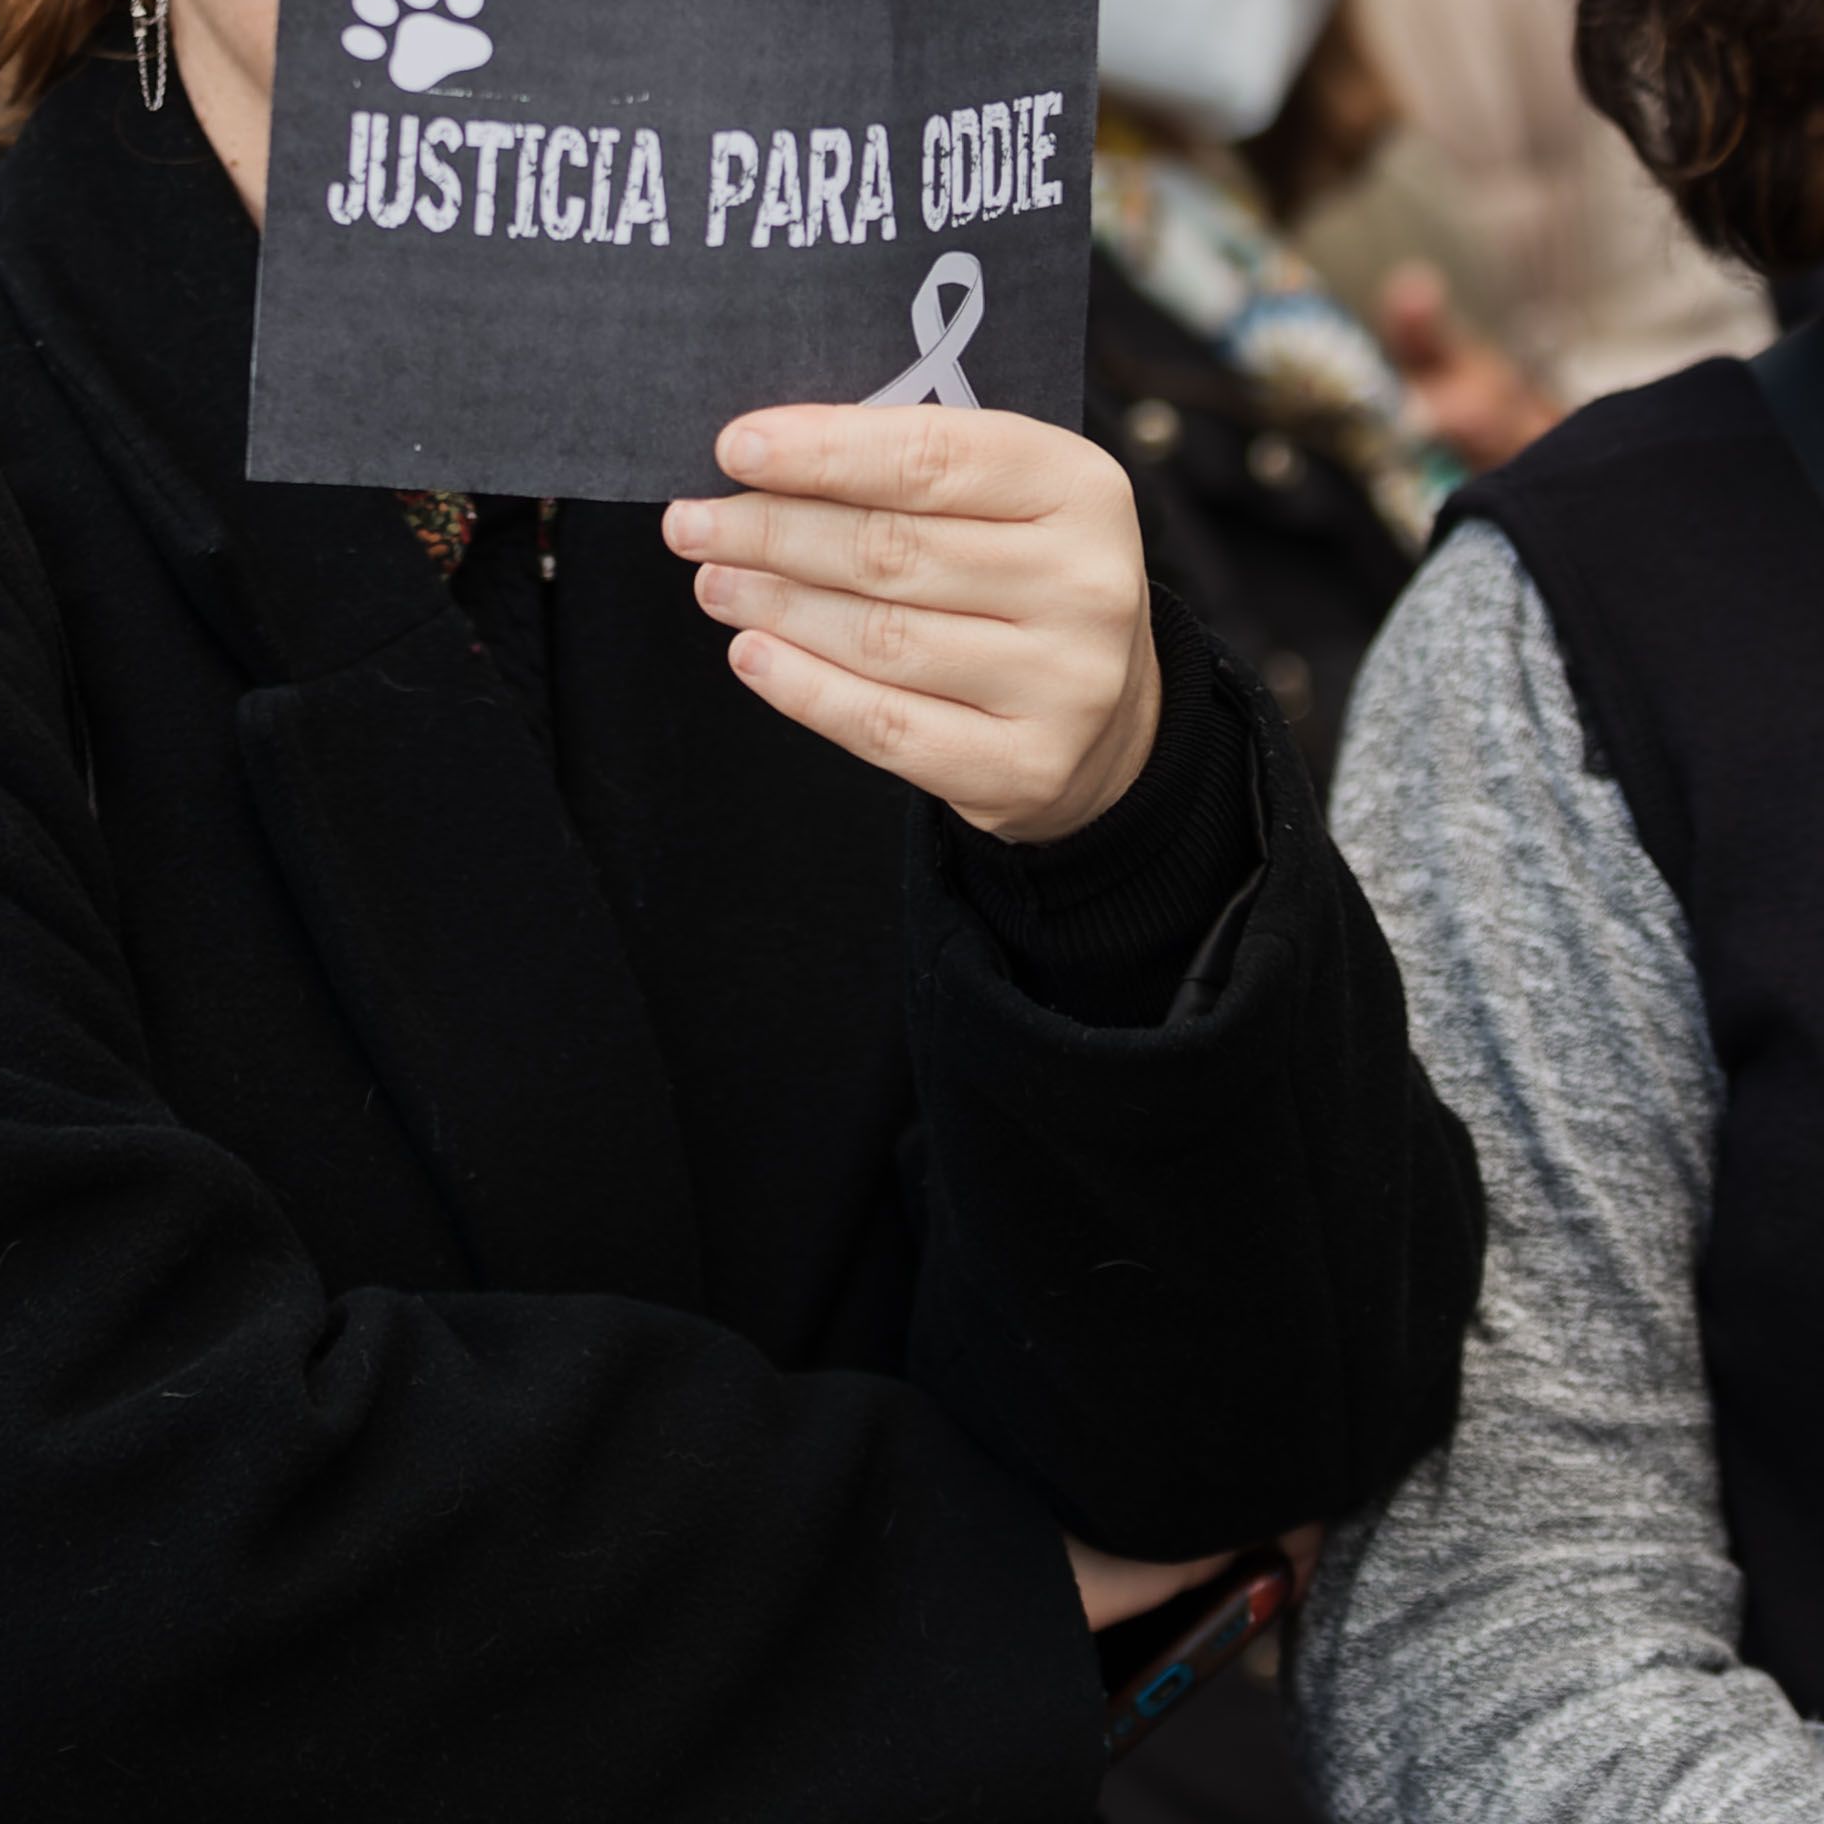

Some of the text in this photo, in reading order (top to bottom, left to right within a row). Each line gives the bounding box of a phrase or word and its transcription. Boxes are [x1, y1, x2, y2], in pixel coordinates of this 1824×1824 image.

[327, 91, 1065, 248] JUSTICIA PARA ODDIE
